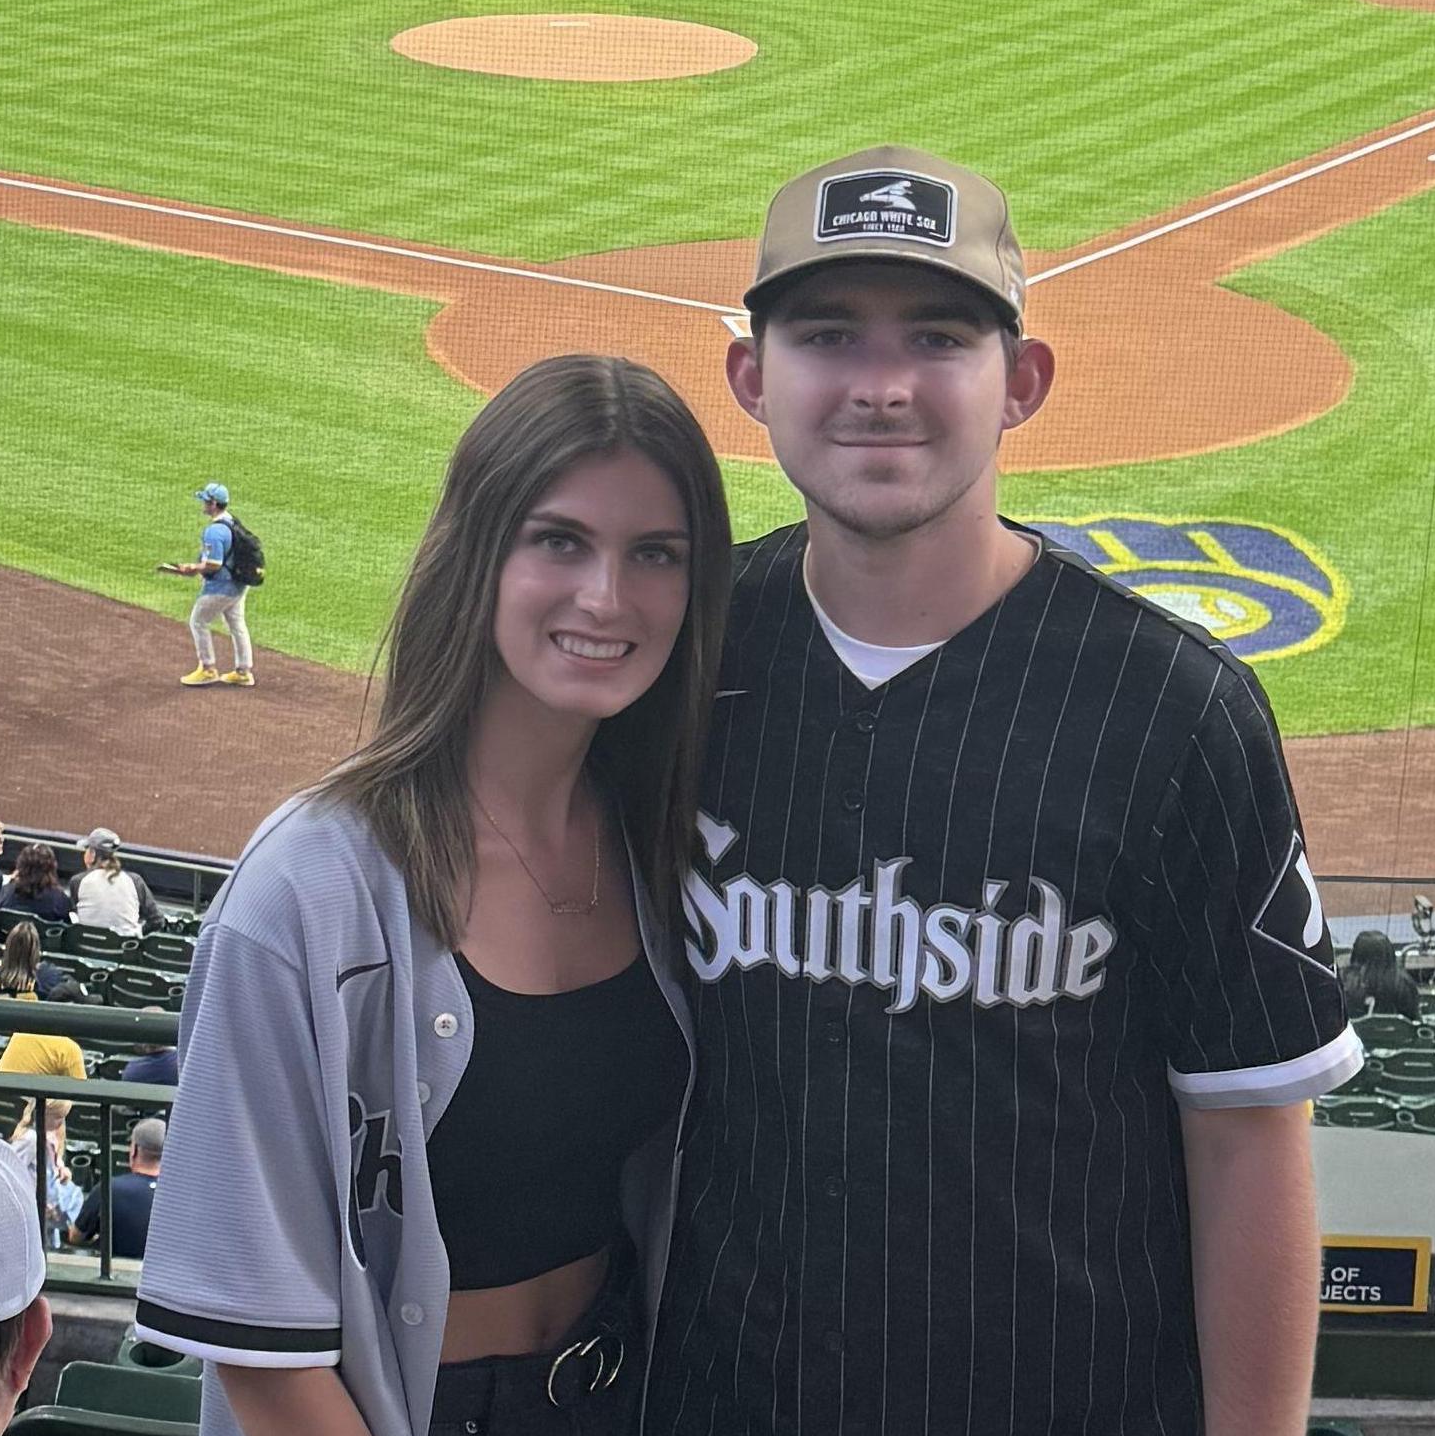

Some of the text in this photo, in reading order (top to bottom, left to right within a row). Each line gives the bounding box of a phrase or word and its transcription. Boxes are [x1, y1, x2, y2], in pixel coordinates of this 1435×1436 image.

[833, 210, 878, 226] CHICAGO
[880, 211, 913, 226] WHITE
[683, 809, 1119, 1014] Southside
[1330, 1267, 1361, 1282] OF
